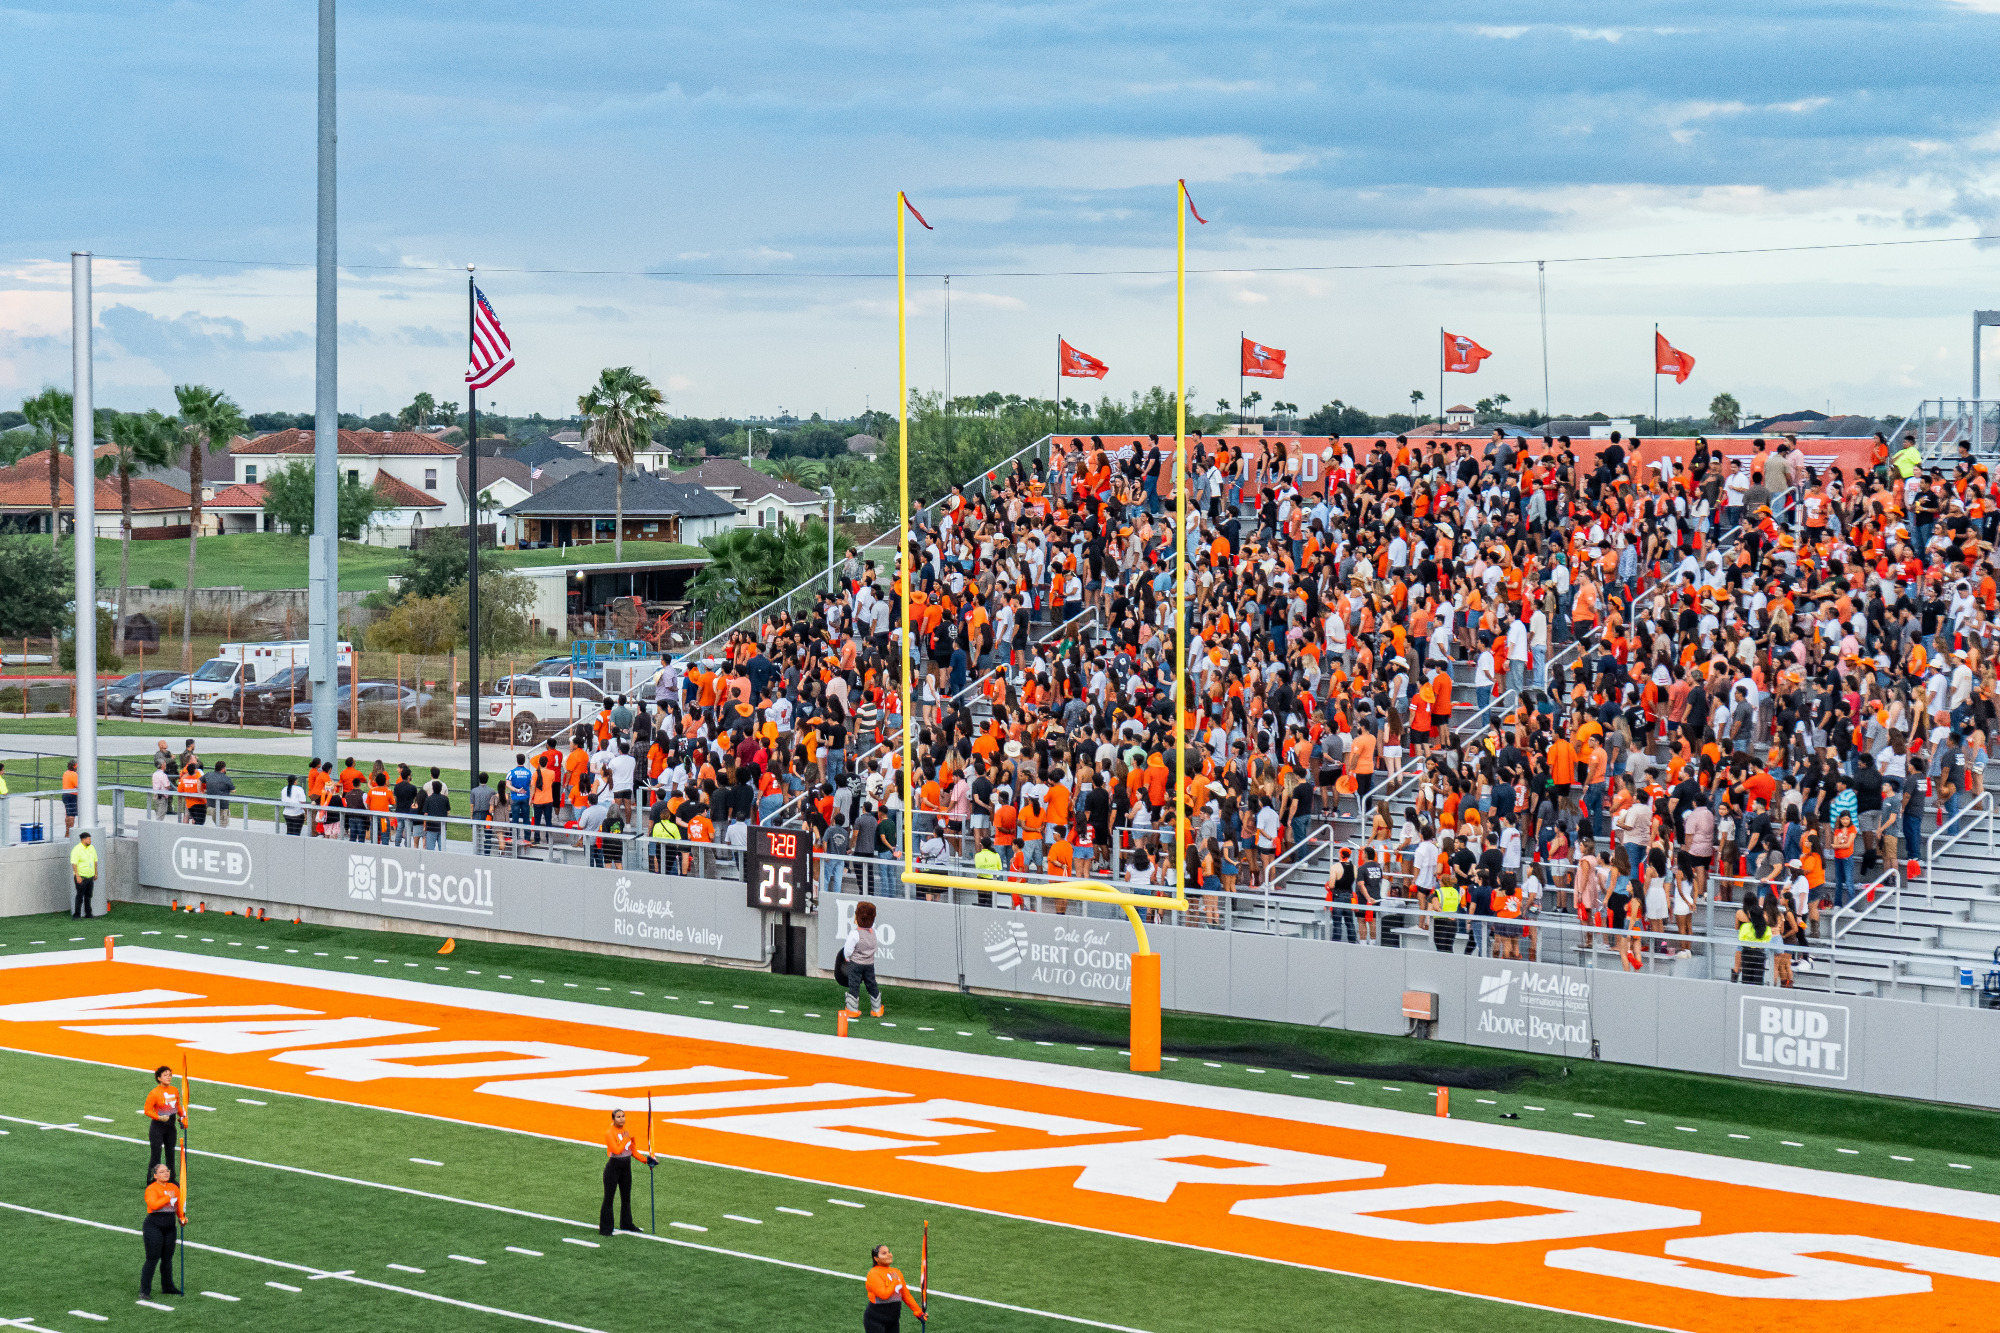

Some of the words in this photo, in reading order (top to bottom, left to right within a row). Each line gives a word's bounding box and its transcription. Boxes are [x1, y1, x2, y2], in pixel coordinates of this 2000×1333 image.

[766, 831, 797, 859] 7:28
[381, 857, 494, 907] Driscoll
[760, 864, 793, 905] 25
[614, 918, 634, 936] Rio
[637, 921, 684, 942] Grande
[686, 926, 724, 951] Valley
[835, 898, 896, 946] Ro
[1054, 926, 1080, 943] Dale
[1031, 943, 1070, 965] BERT
[1031, 966, 1076, 986] AUTO
[1520, 971, 1590, 998] McAllen
[1760, 1005, 1829, 1040] BUD
[1746, 1032, 1842, 1071] LIGHT
[0, 987, 2000, 1301] VAQUEROS
